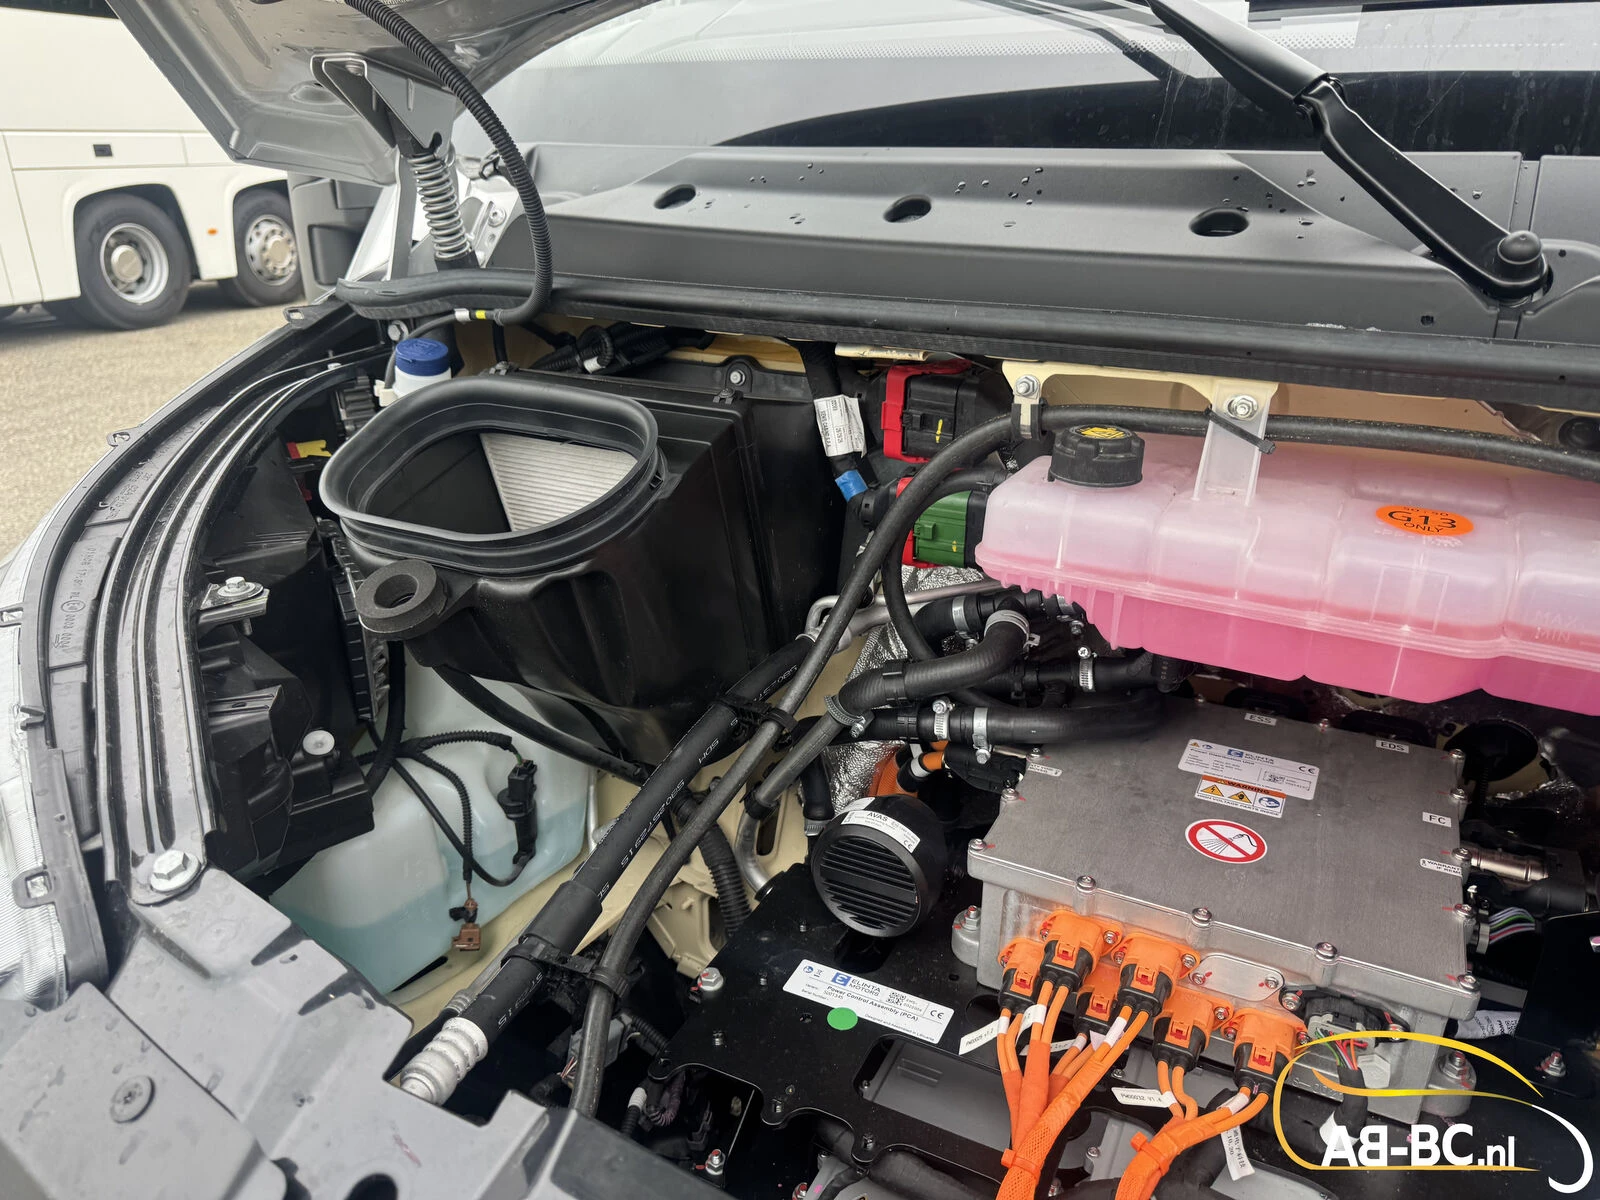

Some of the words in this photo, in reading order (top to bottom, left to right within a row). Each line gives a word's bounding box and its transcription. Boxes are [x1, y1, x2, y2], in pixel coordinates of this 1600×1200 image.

[1388, 510, 1457, 529] G13
[1404, 522, 1443, 533] ONLY
[1250, 715, 1272, 724] ESS
[1380, 741, 1405, 752] EDS
[1227, 780, 1270, 795] WARNING
[866, 811, 889, 821] AVAS
[1428, 815, 1447, 826] FC
[849, 982, 880, 997] MOTORS
[851, 978, 881, 993] ELINTA
[827, 985, 846, 996] Power
[846, 992, 870, 1004] Control
[869, 1000, 900, 1016] Assembly
[899, 1010, 919, 1022] (PCA)
